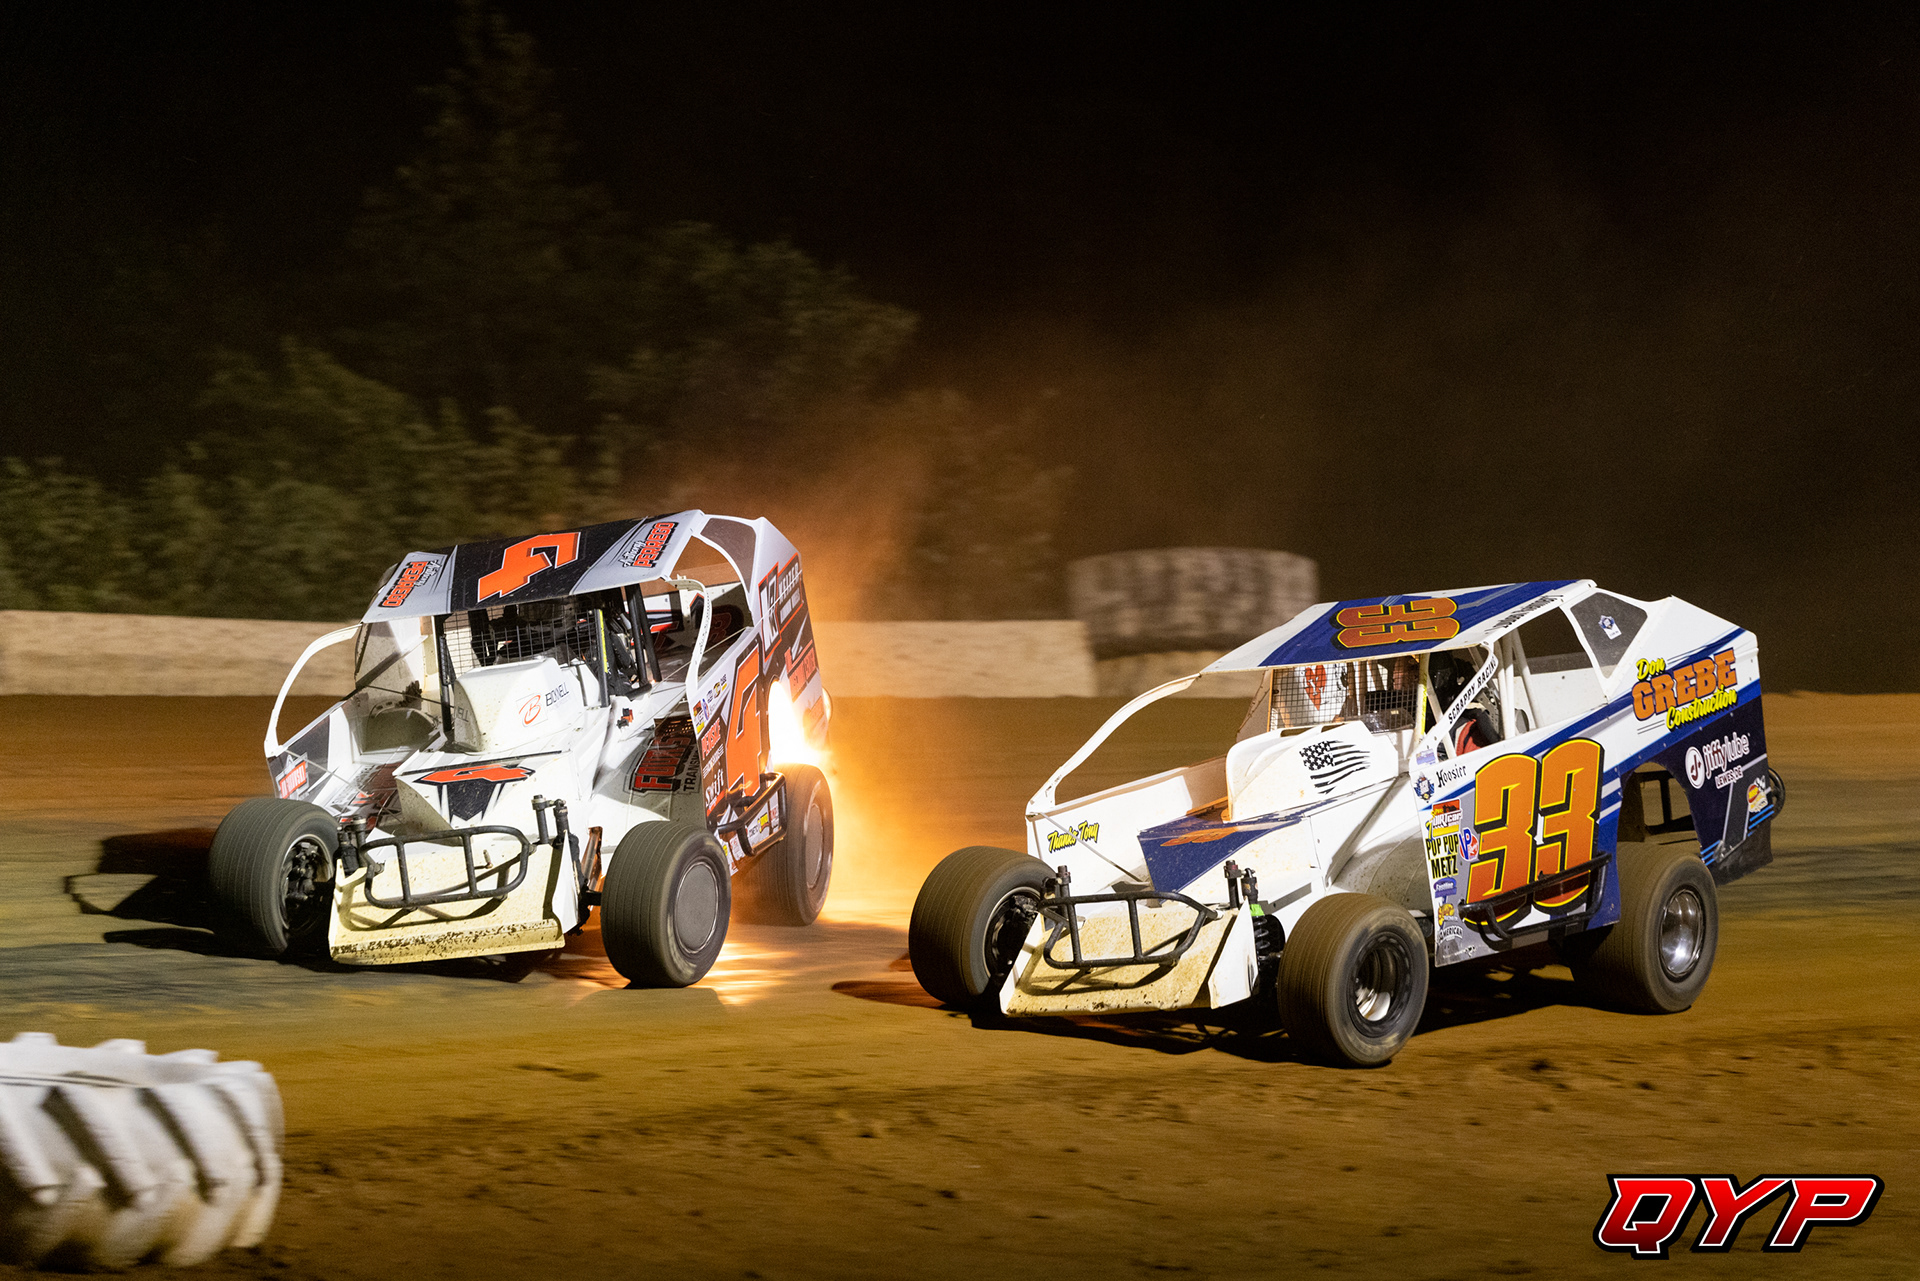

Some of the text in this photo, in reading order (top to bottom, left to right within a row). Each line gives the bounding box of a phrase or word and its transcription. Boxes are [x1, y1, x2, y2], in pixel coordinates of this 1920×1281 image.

[478, 531, 581, 603] 4
[632, 522, 679, 568] PERREGO
[378, 561, 428, 608] PERREGO
[1332, 597, 1461, 649] 33
[1632, 647, 1737, 721] GREBE
[1636, 658, 1666, 681] Don
[726, 648, 761, 798] 4
[1448, 683, 1475, 724] SCRAPPY
[1666, 684, 1738, 732] Construction
[701, 717, 721, 761] PENSKE
[1436, 764, 1466, 788] Hoosier
[1047, 820, 1099, 853] Thanks Tony
[1425, 836, 1441, 860] POP
[1443, 833, 1459, 854] POP
[1459, 828, 1472, 860] VP
[1465, 738, 1604, 926] 33
[1430, 855, 1458, 879] METZ
